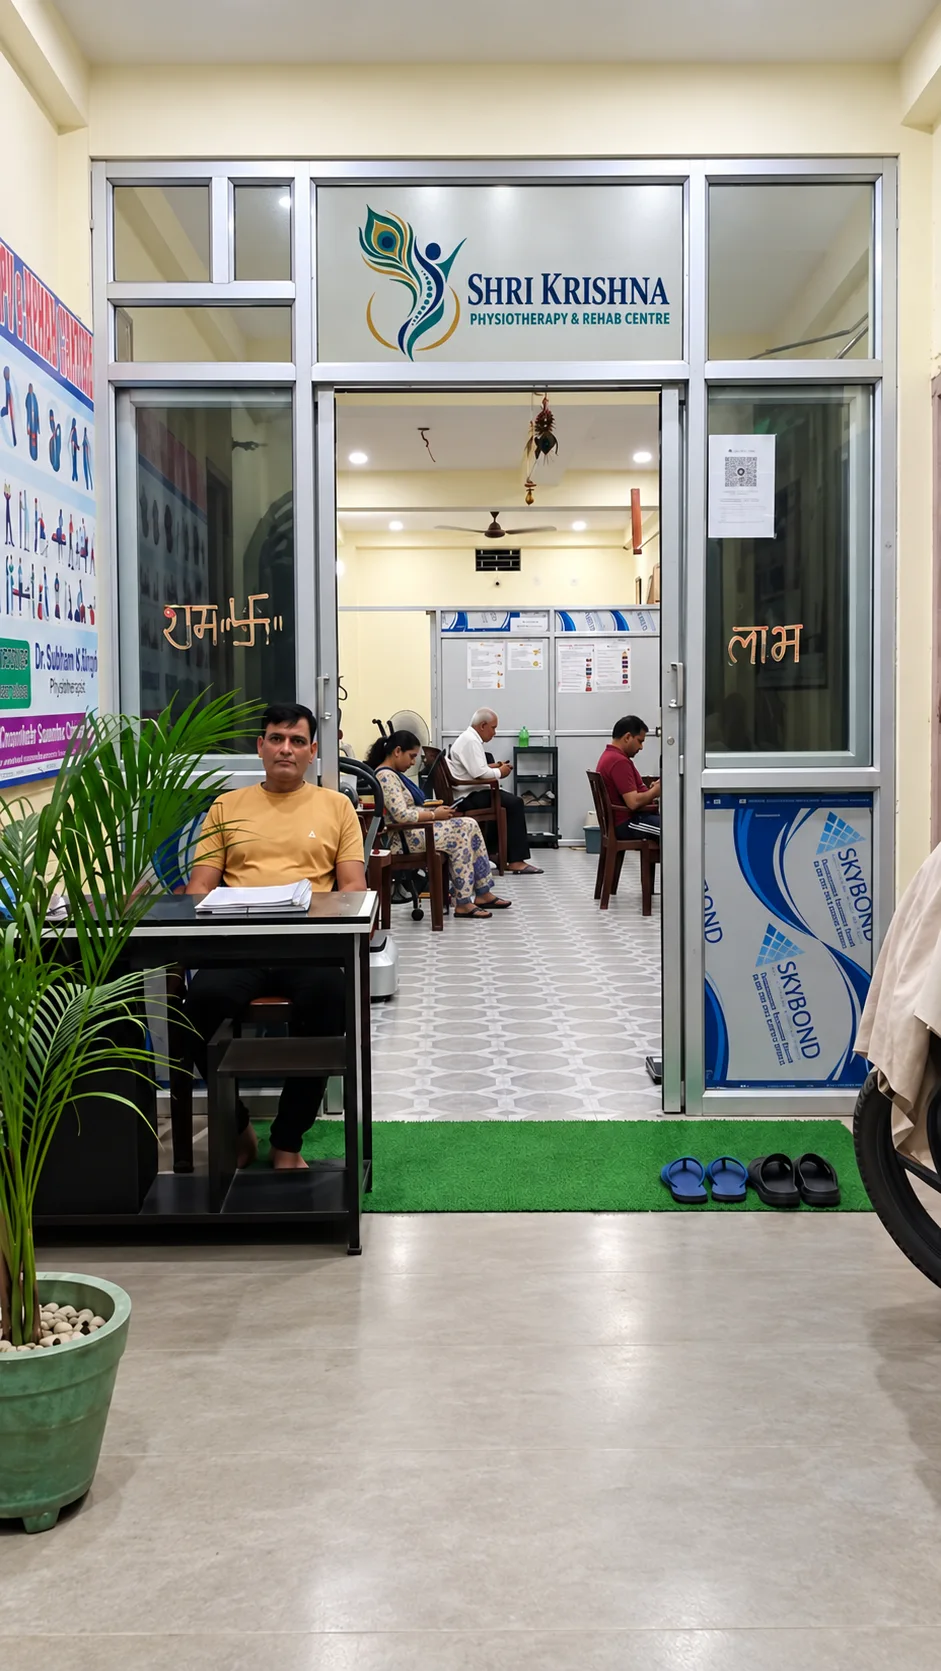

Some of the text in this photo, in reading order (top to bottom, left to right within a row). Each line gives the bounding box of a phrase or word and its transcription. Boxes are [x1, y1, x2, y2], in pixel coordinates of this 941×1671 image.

[468, 273, 670, 306] SHRI KRISHNA
[470, 312, 670, 326] PHYSIOTHERAPY & REHAB CENTRE
[704, 878, 723, 944] OND
[777, 961, 820, 1059] SKYBOND
